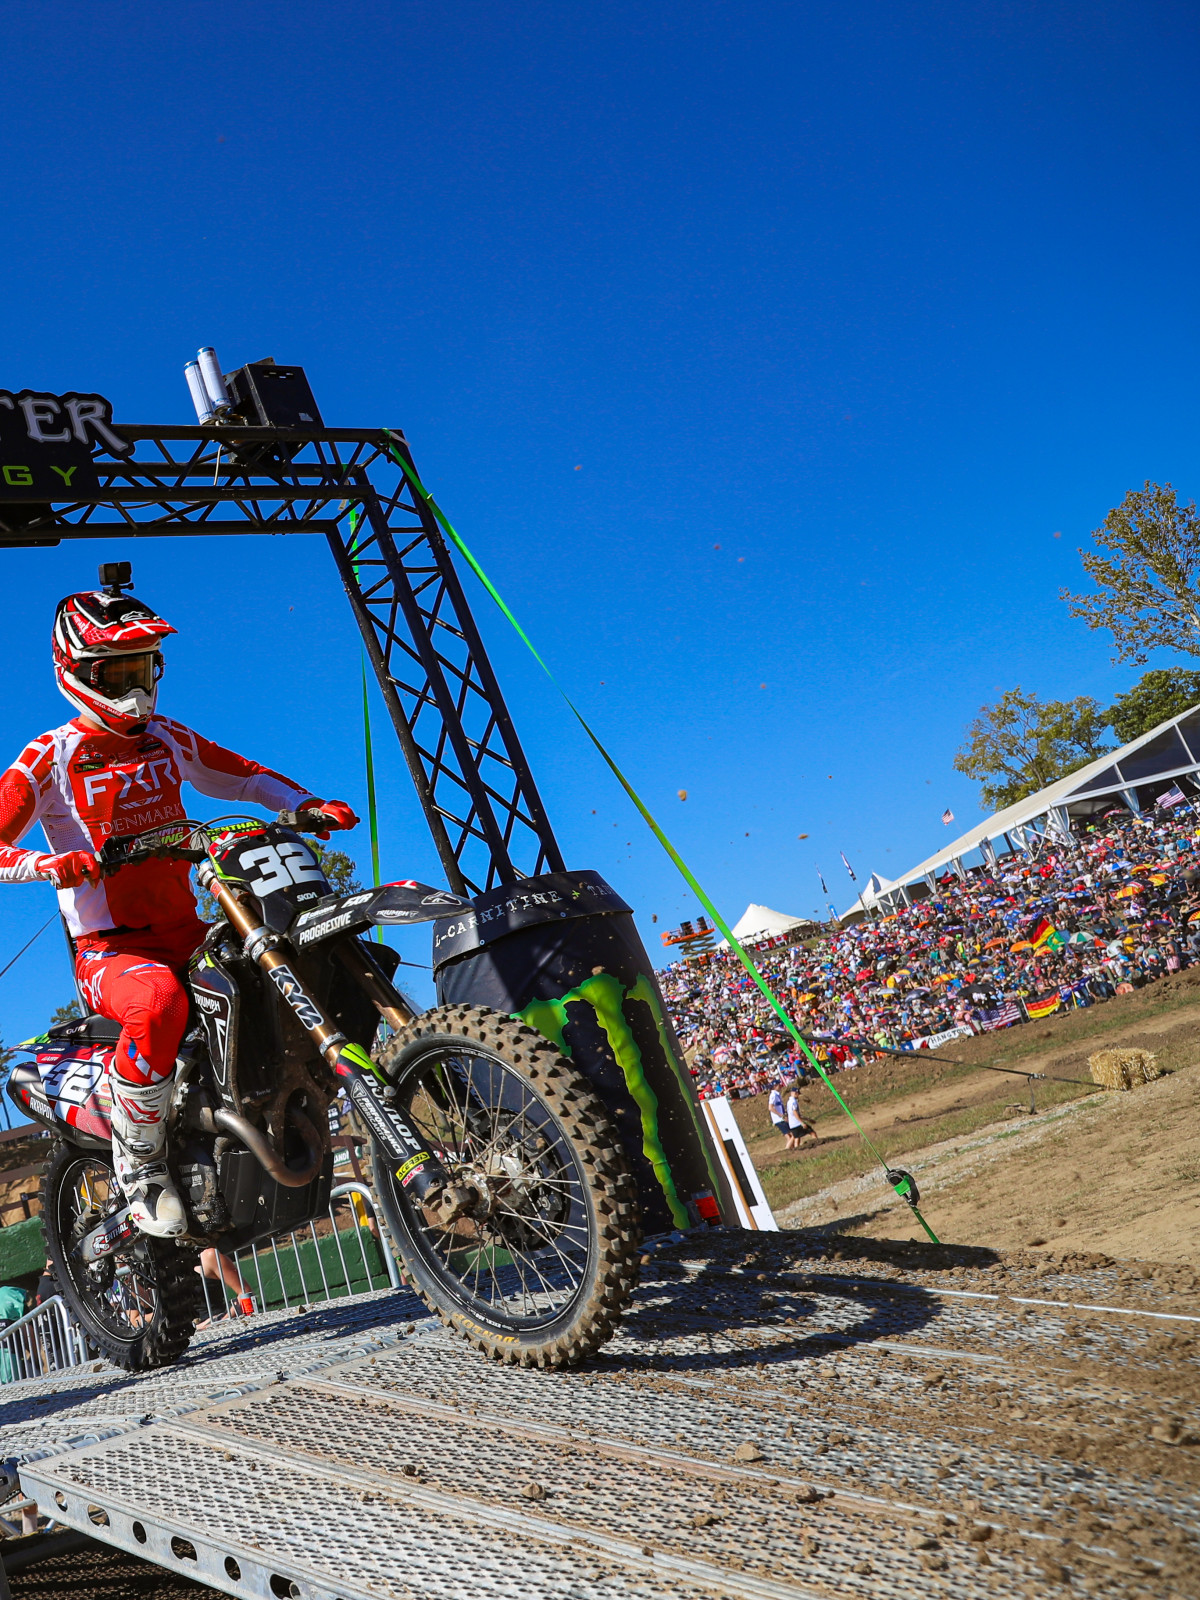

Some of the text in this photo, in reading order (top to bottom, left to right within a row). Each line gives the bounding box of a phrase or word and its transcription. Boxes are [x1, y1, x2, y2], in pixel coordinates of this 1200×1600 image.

[83, 757, 178, 807] FXR
[99, 802, 183, 836] DENMARK
[238, 842, 326, 898] 32
[296, 891, 318, 902] SKDA
[341, 892, 375, 909] FXR
[375, 908, 411, 919] TRIUMPH
[299, 910, 355, 946] PROGRESSIVE
[434, 889, 564, 948] L-CARNITINE
[193, 992, 222, 1012] TRIUMPH
[267, 963, 325, 1031] KYB
[356, 1099, 388, 1142] LUBRICANTS
[361, 1097, 405, 1155] PERFORMANCE
[397, 1153, 429, 1178] ACERBIS
